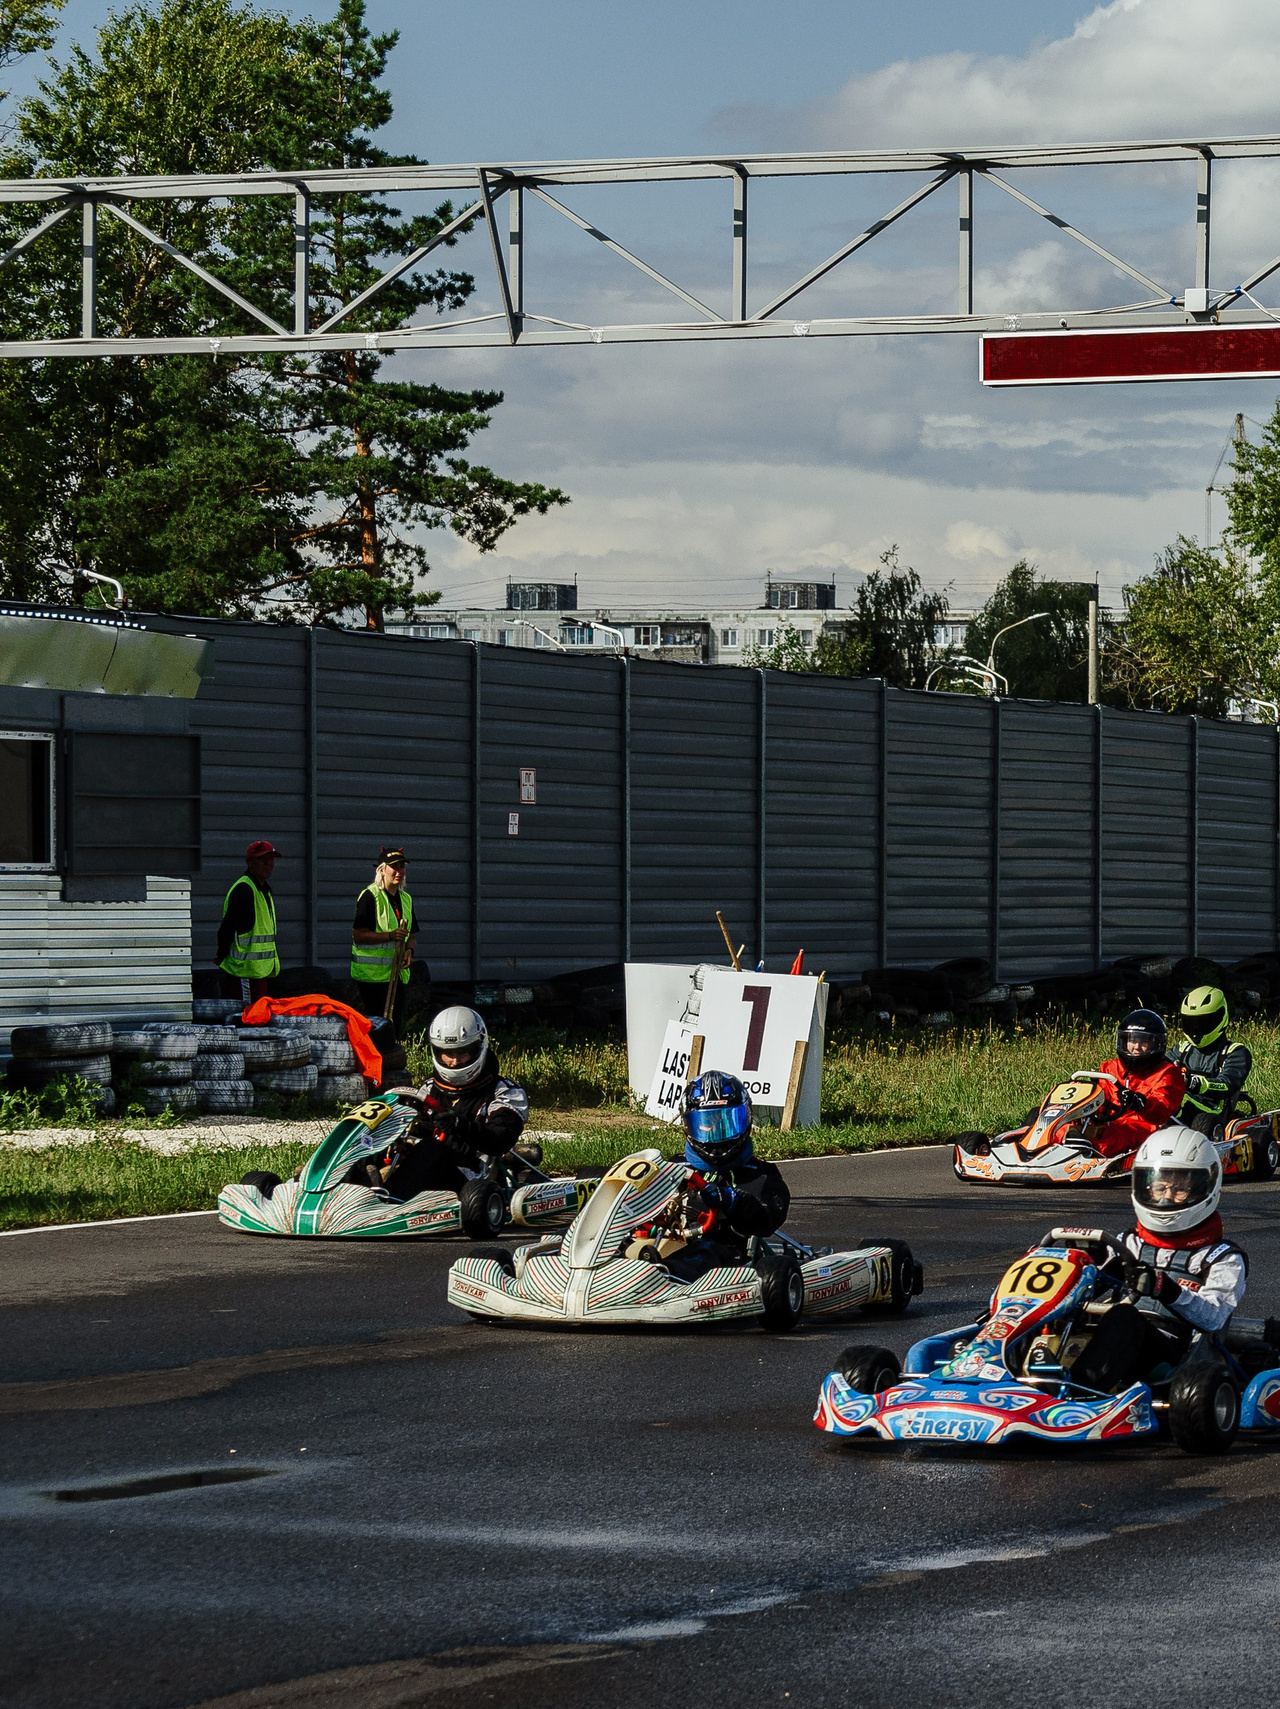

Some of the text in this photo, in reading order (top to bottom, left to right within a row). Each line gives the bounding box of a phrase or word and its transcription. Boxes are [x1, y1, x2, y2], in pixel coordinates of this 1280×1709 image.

[742, 985, 772, 1072] 1
[657, 1080, 682, 1109] LAP
[1060, 1087, 1077, 1100] 3
[1241, 1139, 1249, 1169] 3
[608, 1160, 651, 1180] 10
[810, 1279, 851, 1302] TONY KART
[870, 1255, 890, 1299] 10
[1009, 1260, 1061, 1294] 18
[695, 1297, 720, 1309] TONY
[901, 1411, 986, 1441] Energy
